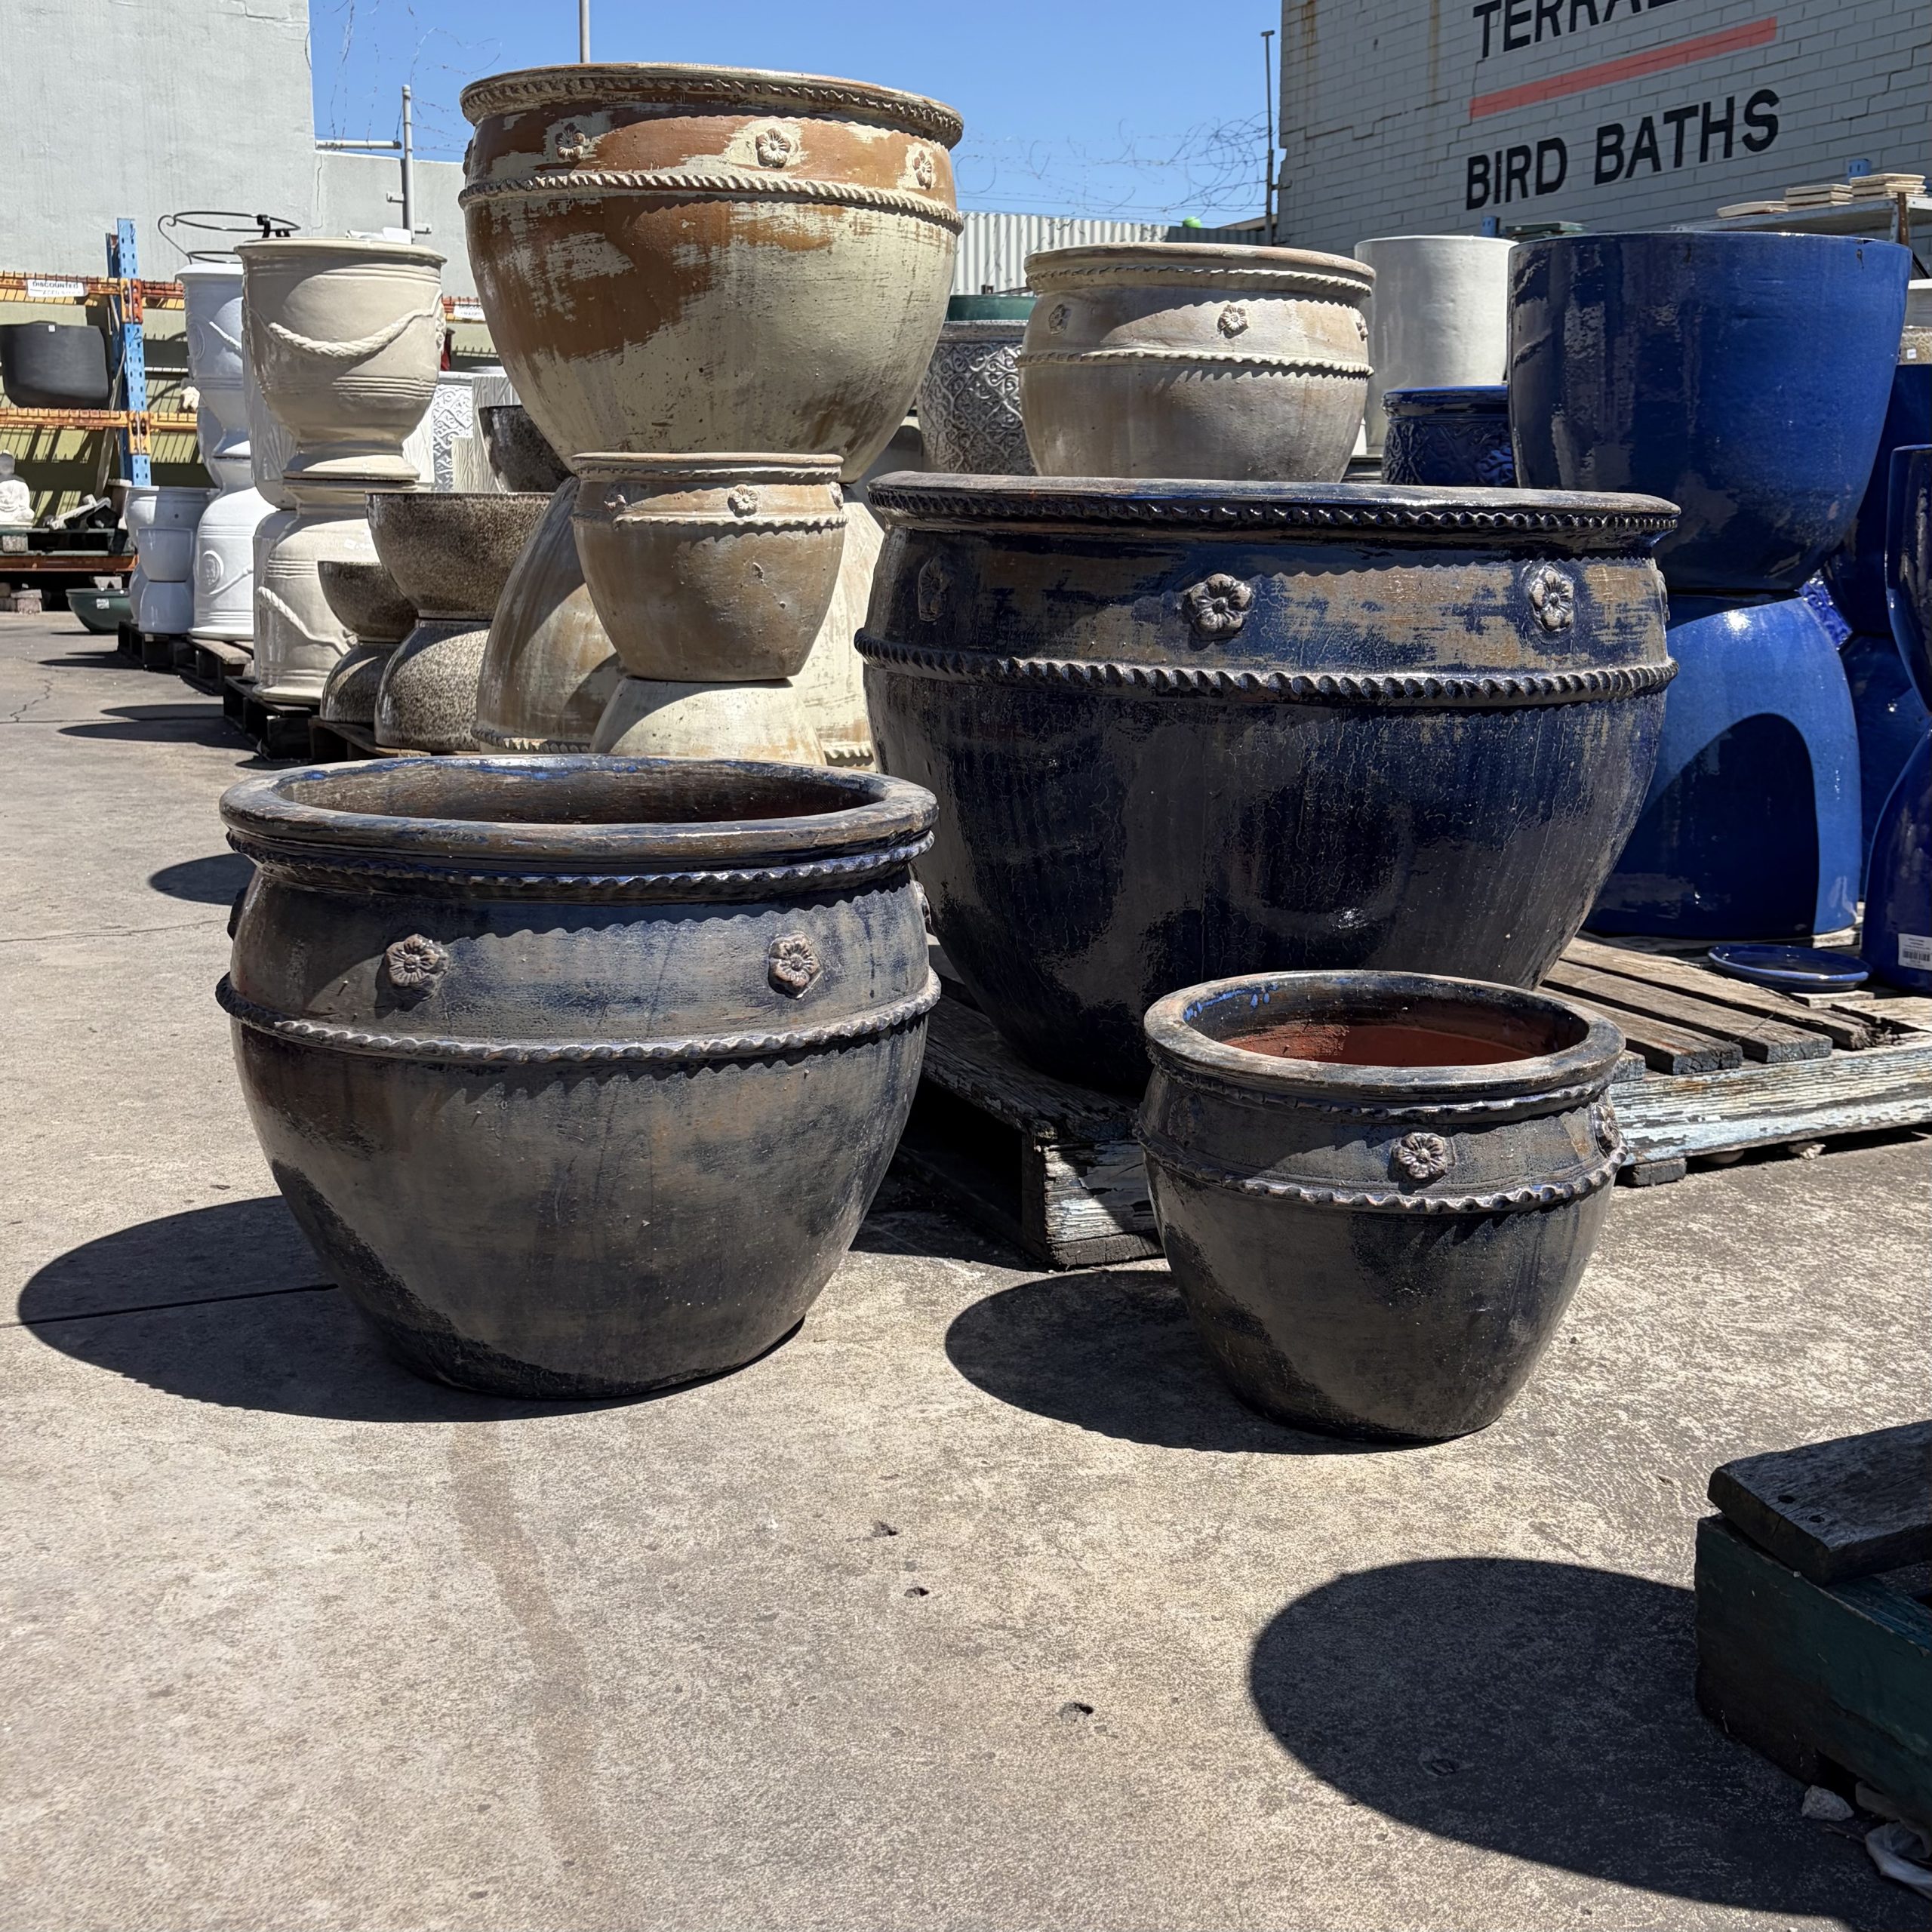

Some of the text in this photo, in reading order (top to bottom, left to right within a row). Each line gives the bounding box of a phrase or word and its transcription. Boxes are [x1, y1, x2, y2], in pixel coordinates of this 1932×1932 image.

[1466, 89, 1780, 211] BIRD BATHS
[32, 281, 78, 289] DISCOUNTED
